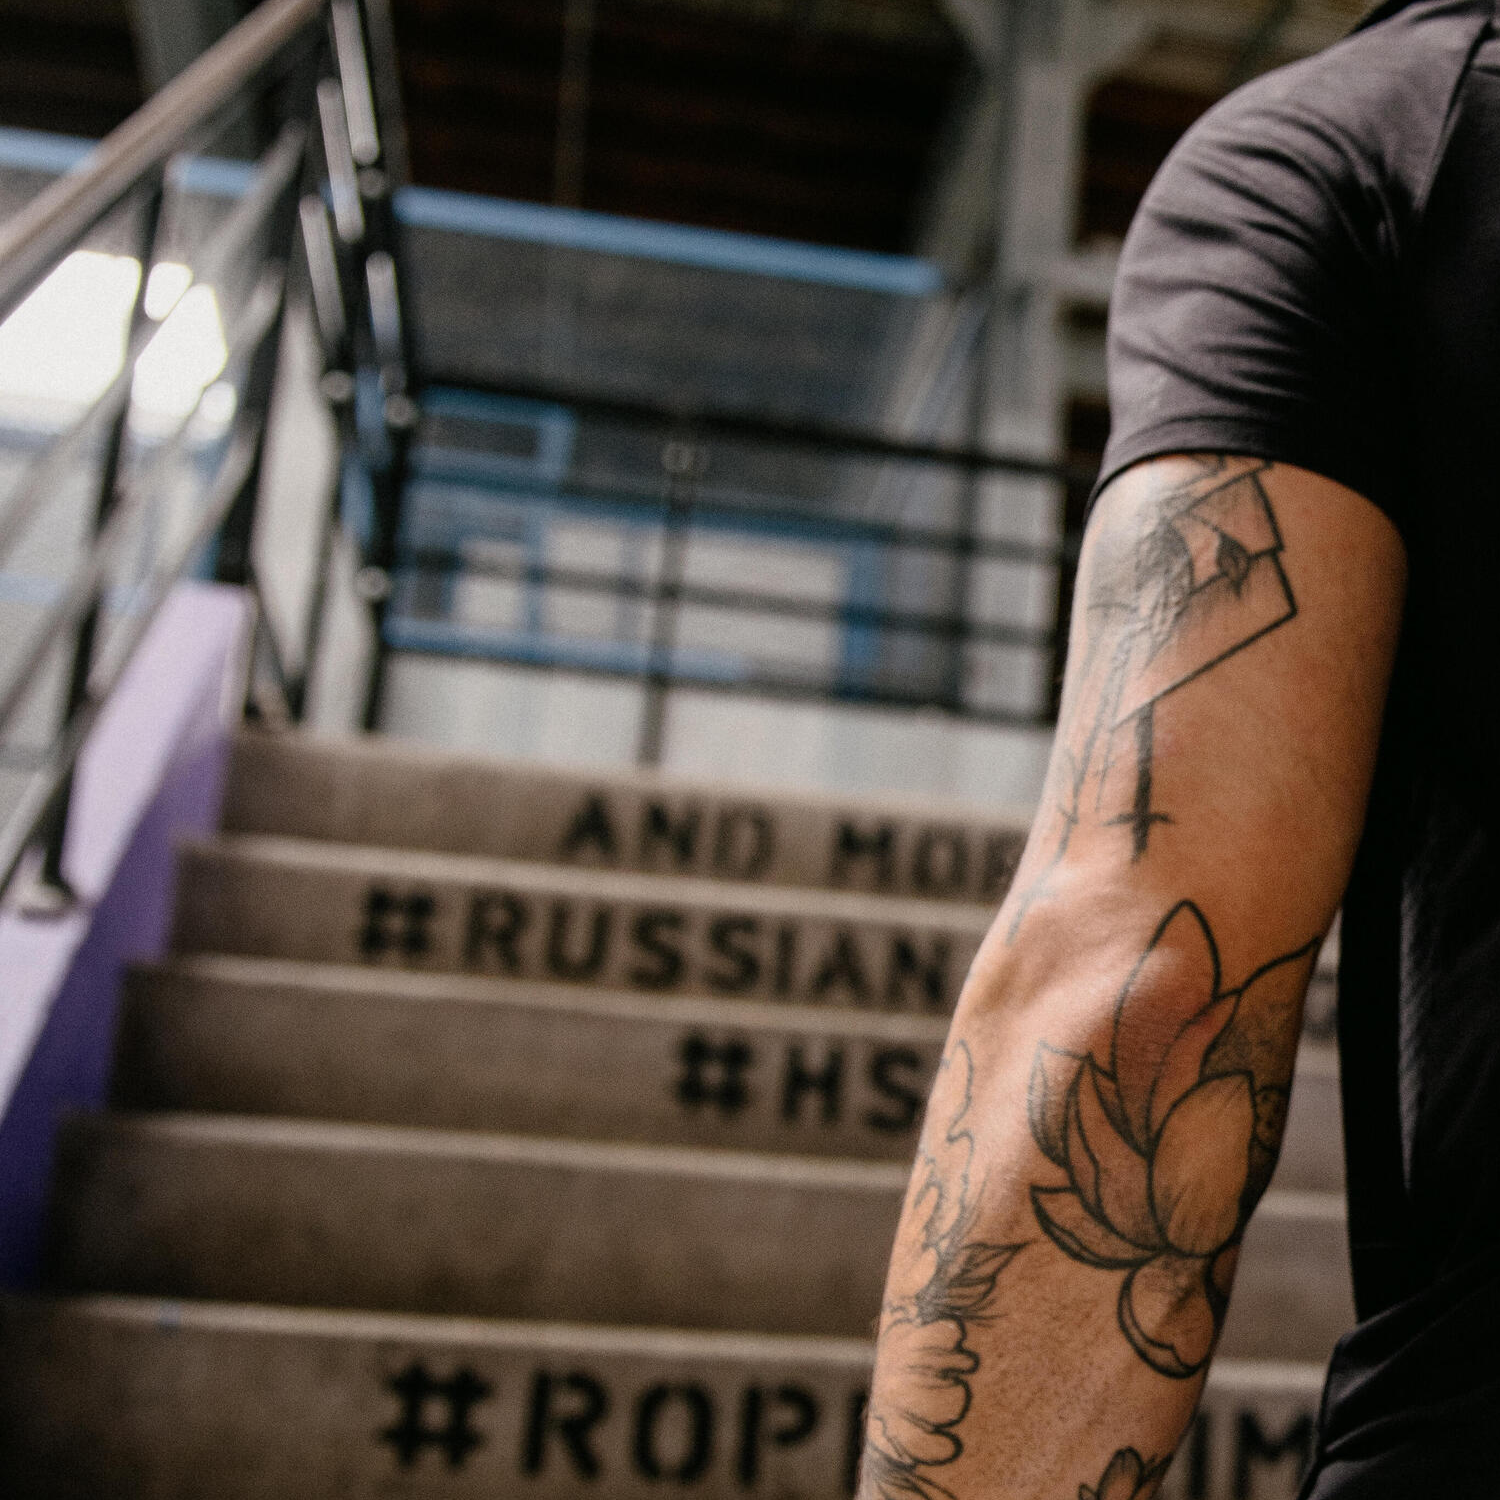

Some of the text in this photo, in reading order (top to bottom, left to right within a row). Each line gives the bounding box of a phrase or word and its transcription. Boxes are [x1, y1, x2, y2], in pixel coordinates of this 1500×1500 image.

[559, 791, 1032, 903] AND MOR
[357, 881, 954, 1011] #RUSSIAN
[673, 1029, 934, 1135] #HS
[383, 1358, 870, 1497] #ROP
